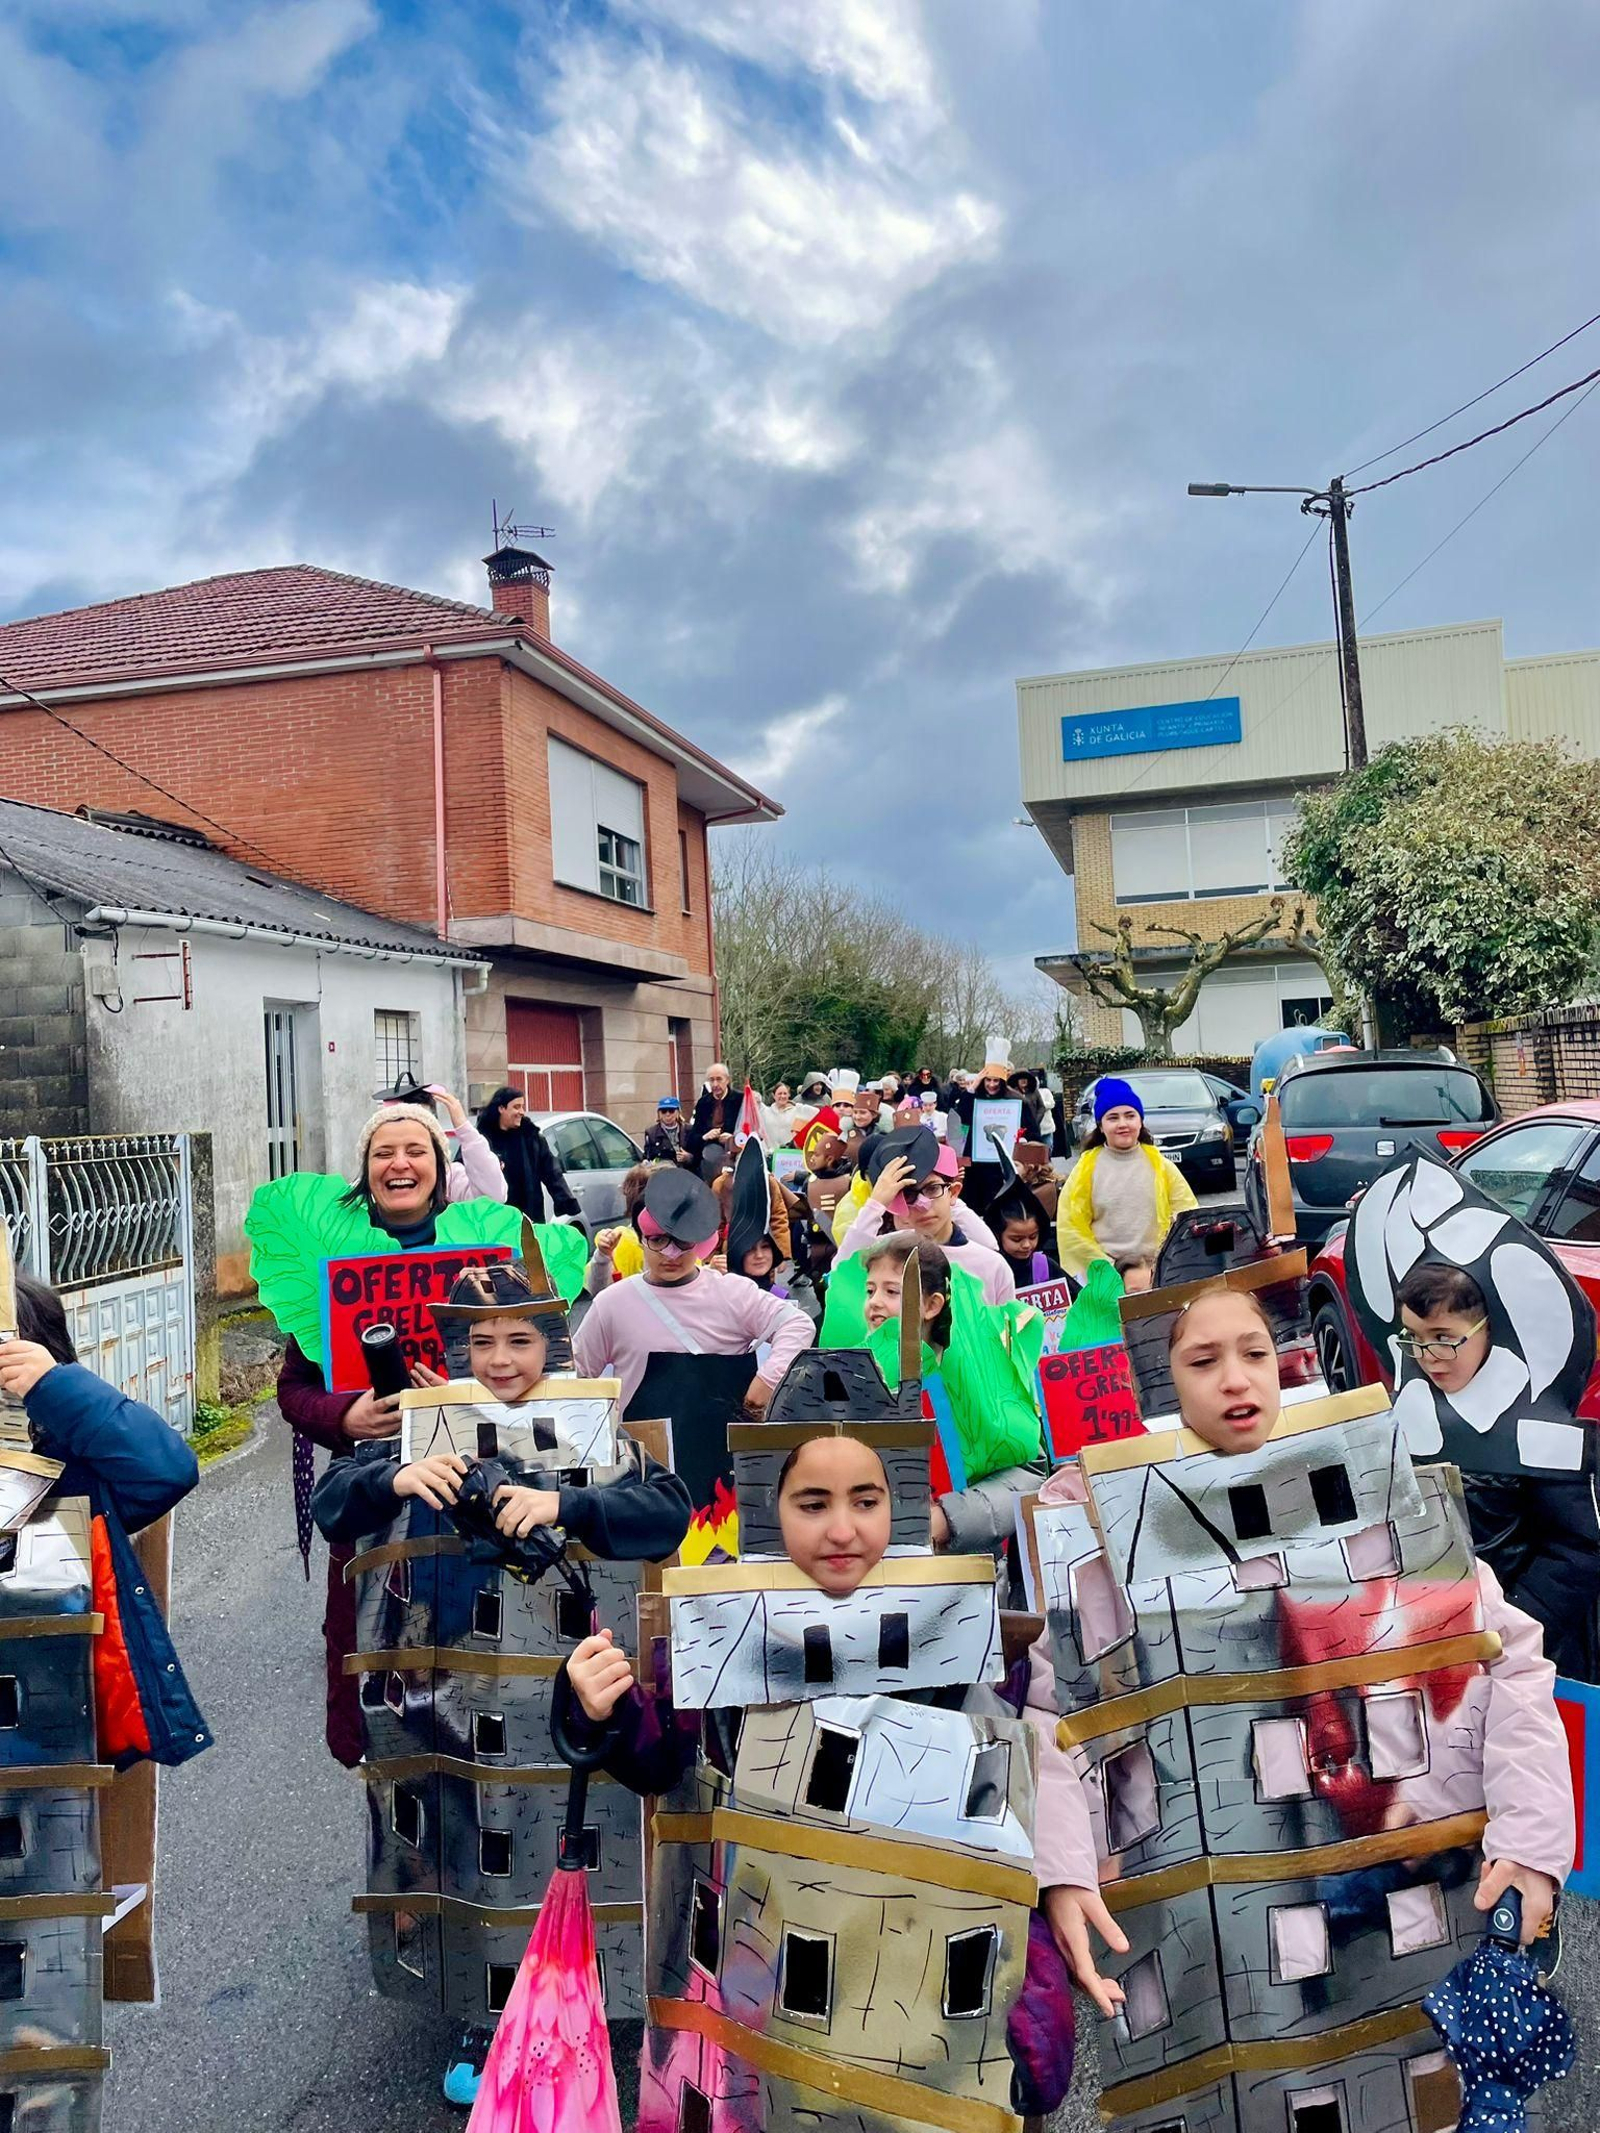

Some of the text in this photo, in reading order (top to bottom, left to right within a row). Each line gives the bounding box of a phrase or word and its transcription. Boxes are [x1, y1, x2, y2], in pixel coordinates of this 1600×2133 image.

[1089, 723, 1125, 735] XUNTA
[1089, 730, 1147, 745] DE GALICIA
